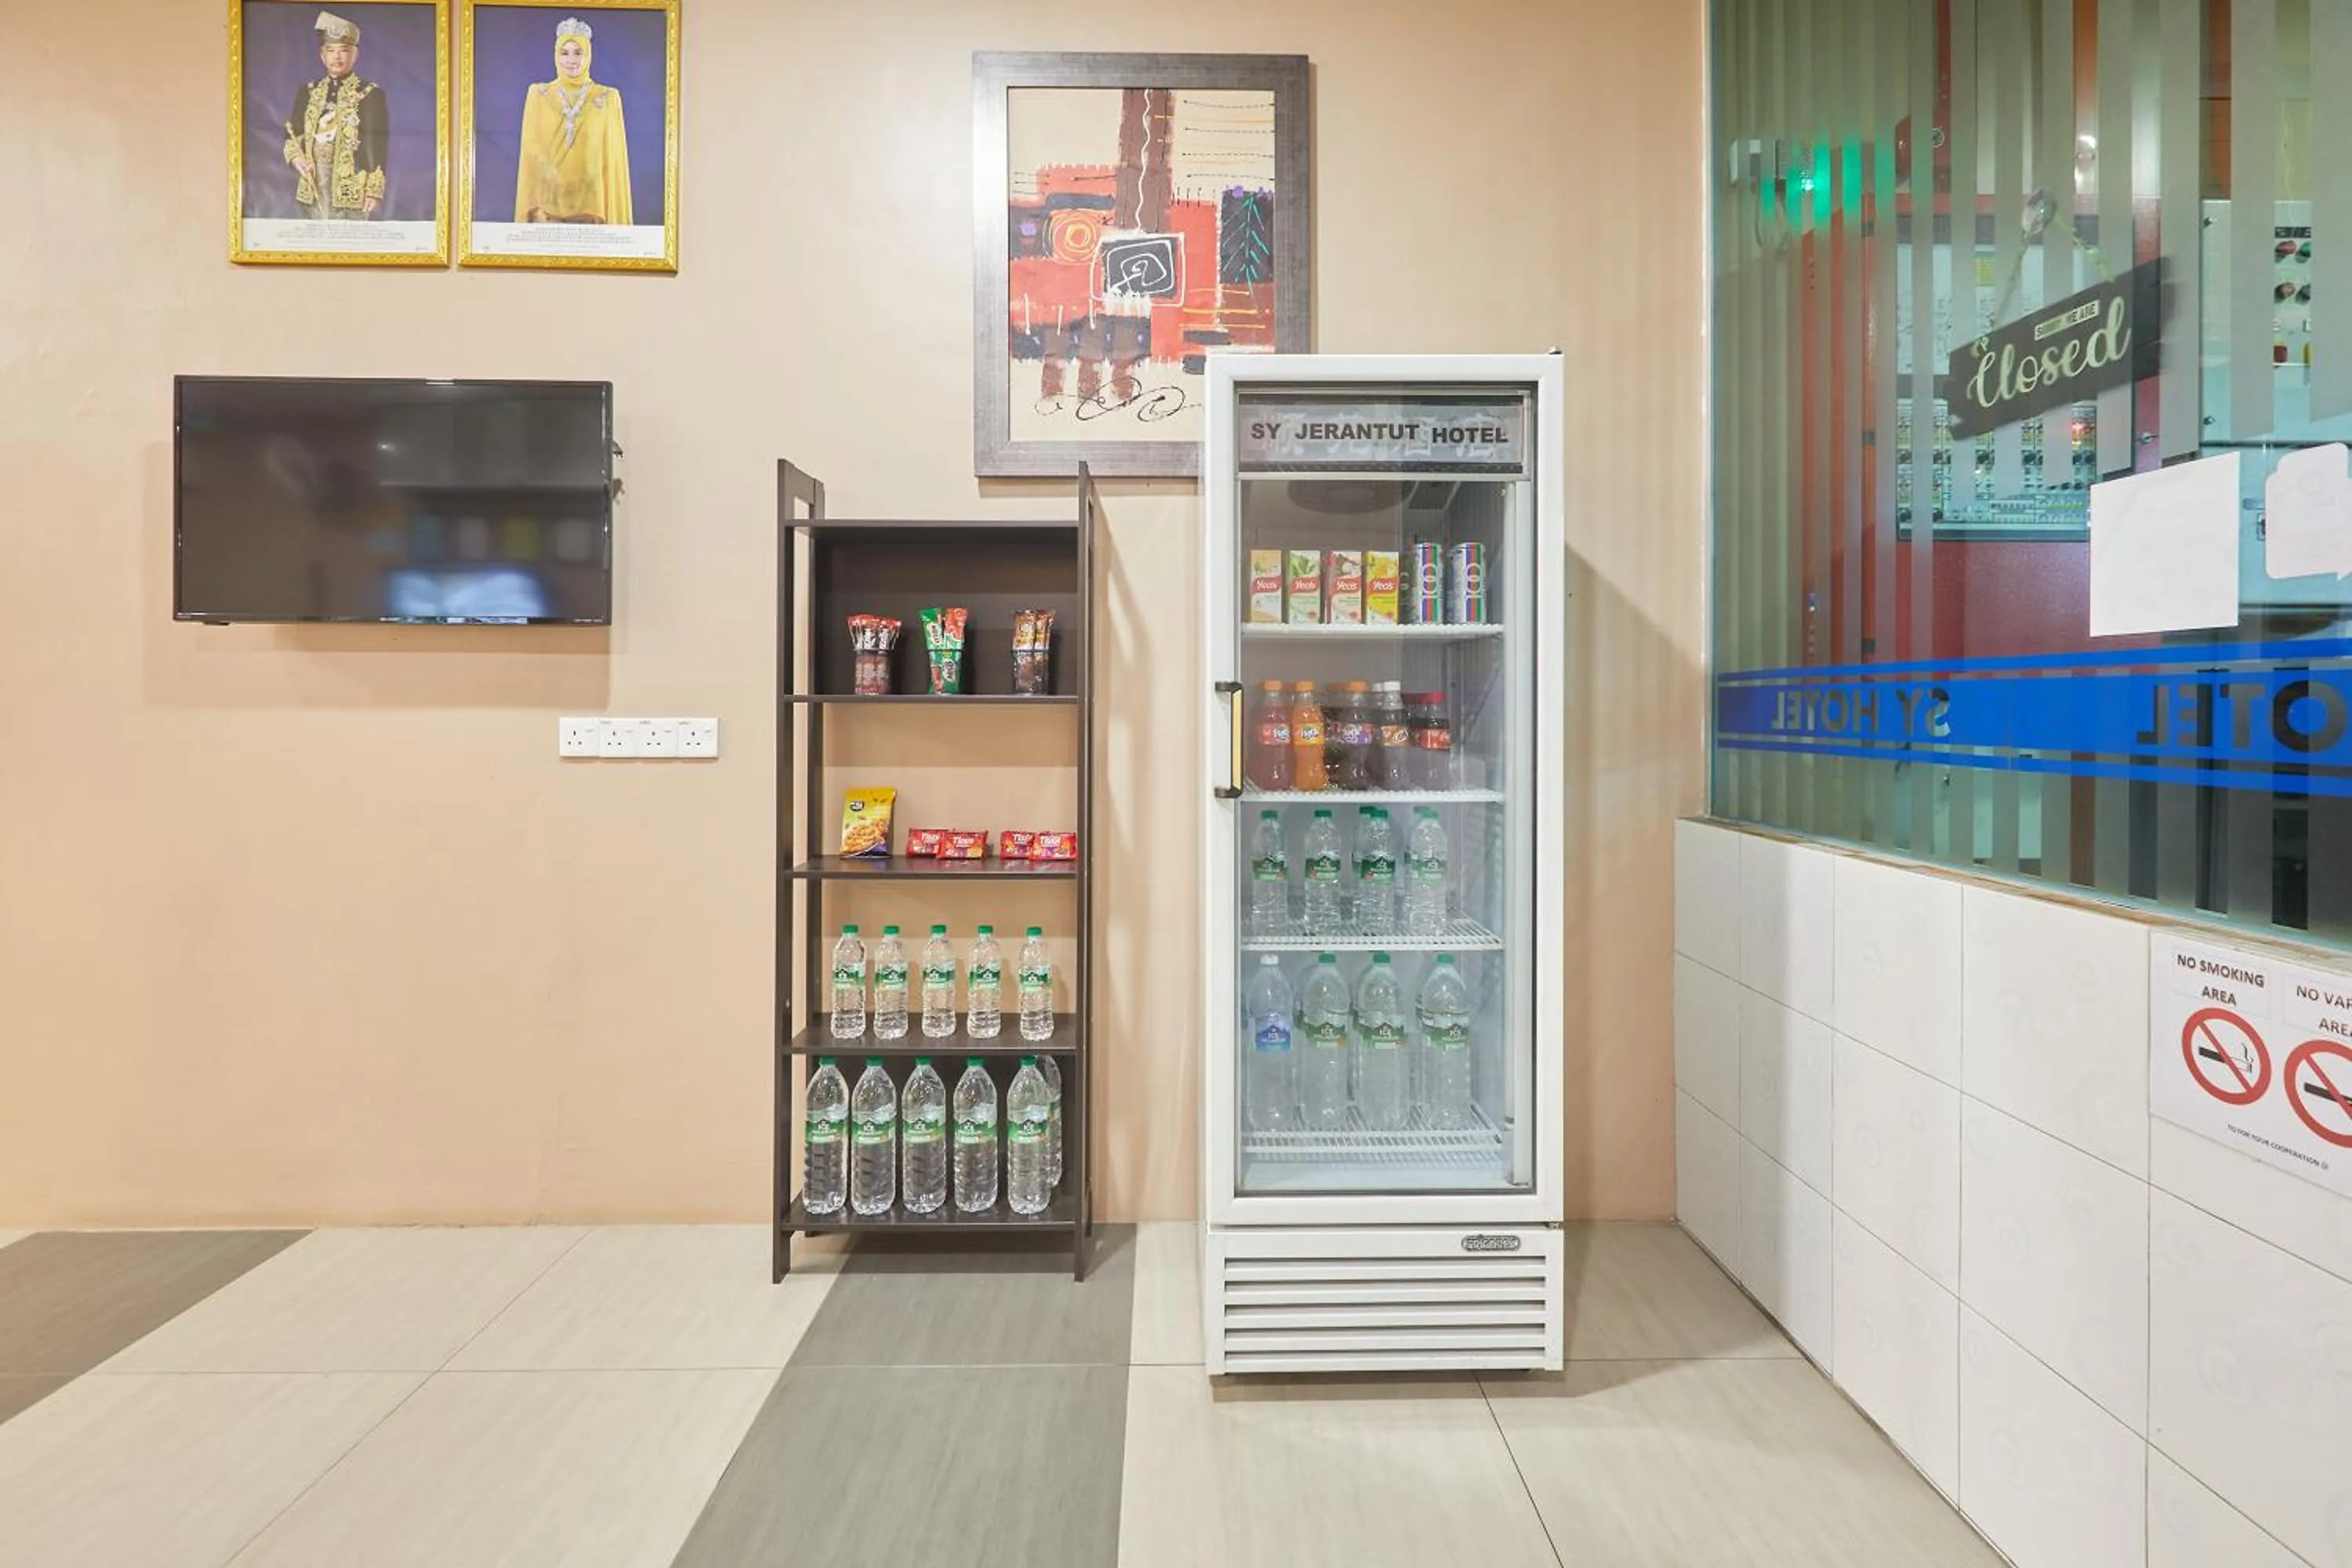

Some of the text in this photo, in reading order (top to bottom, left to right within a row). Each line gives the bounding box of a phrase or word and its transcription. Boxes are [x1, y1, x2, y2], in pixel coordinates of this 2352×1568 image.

[1967, 296, 2132, 408] Closed
[1250, 423, 1509, 445] SY JERANTUT HOTEL
[2177, 954, 2265, 988] NO SMOKING
[2201, 985, 2238, 1007] AREA
[2296, 985, 2319, 1001] NO
[2318, 1018, 2352, 1037] ARE
[2270, 1142, 2321, 1167] COOPERATION
